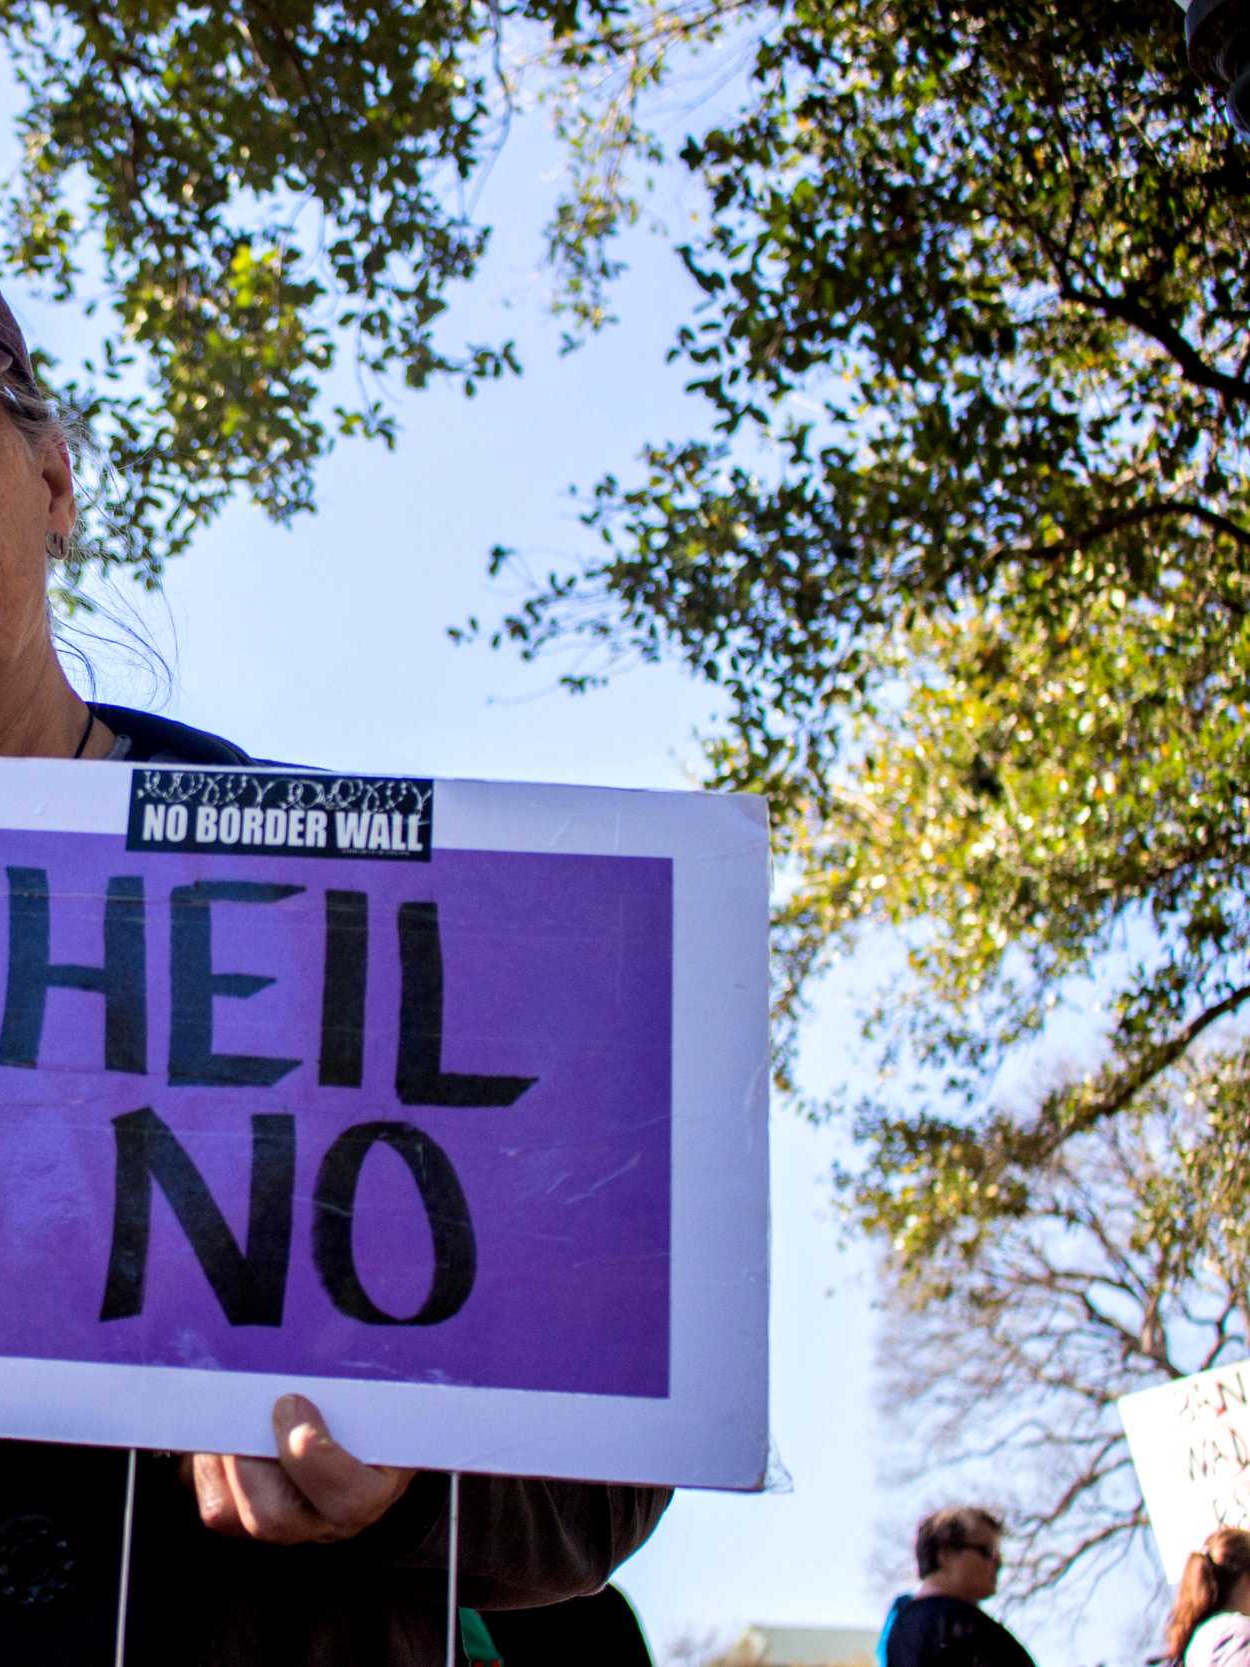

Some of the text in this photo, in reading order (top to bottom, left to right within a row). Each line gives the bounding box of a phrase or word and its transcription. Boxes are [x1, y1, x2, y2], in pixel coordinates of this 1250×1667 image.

[142, 804, 423, 851] NO BORDER WALL
[98, 1107, 478, 1328] NO
